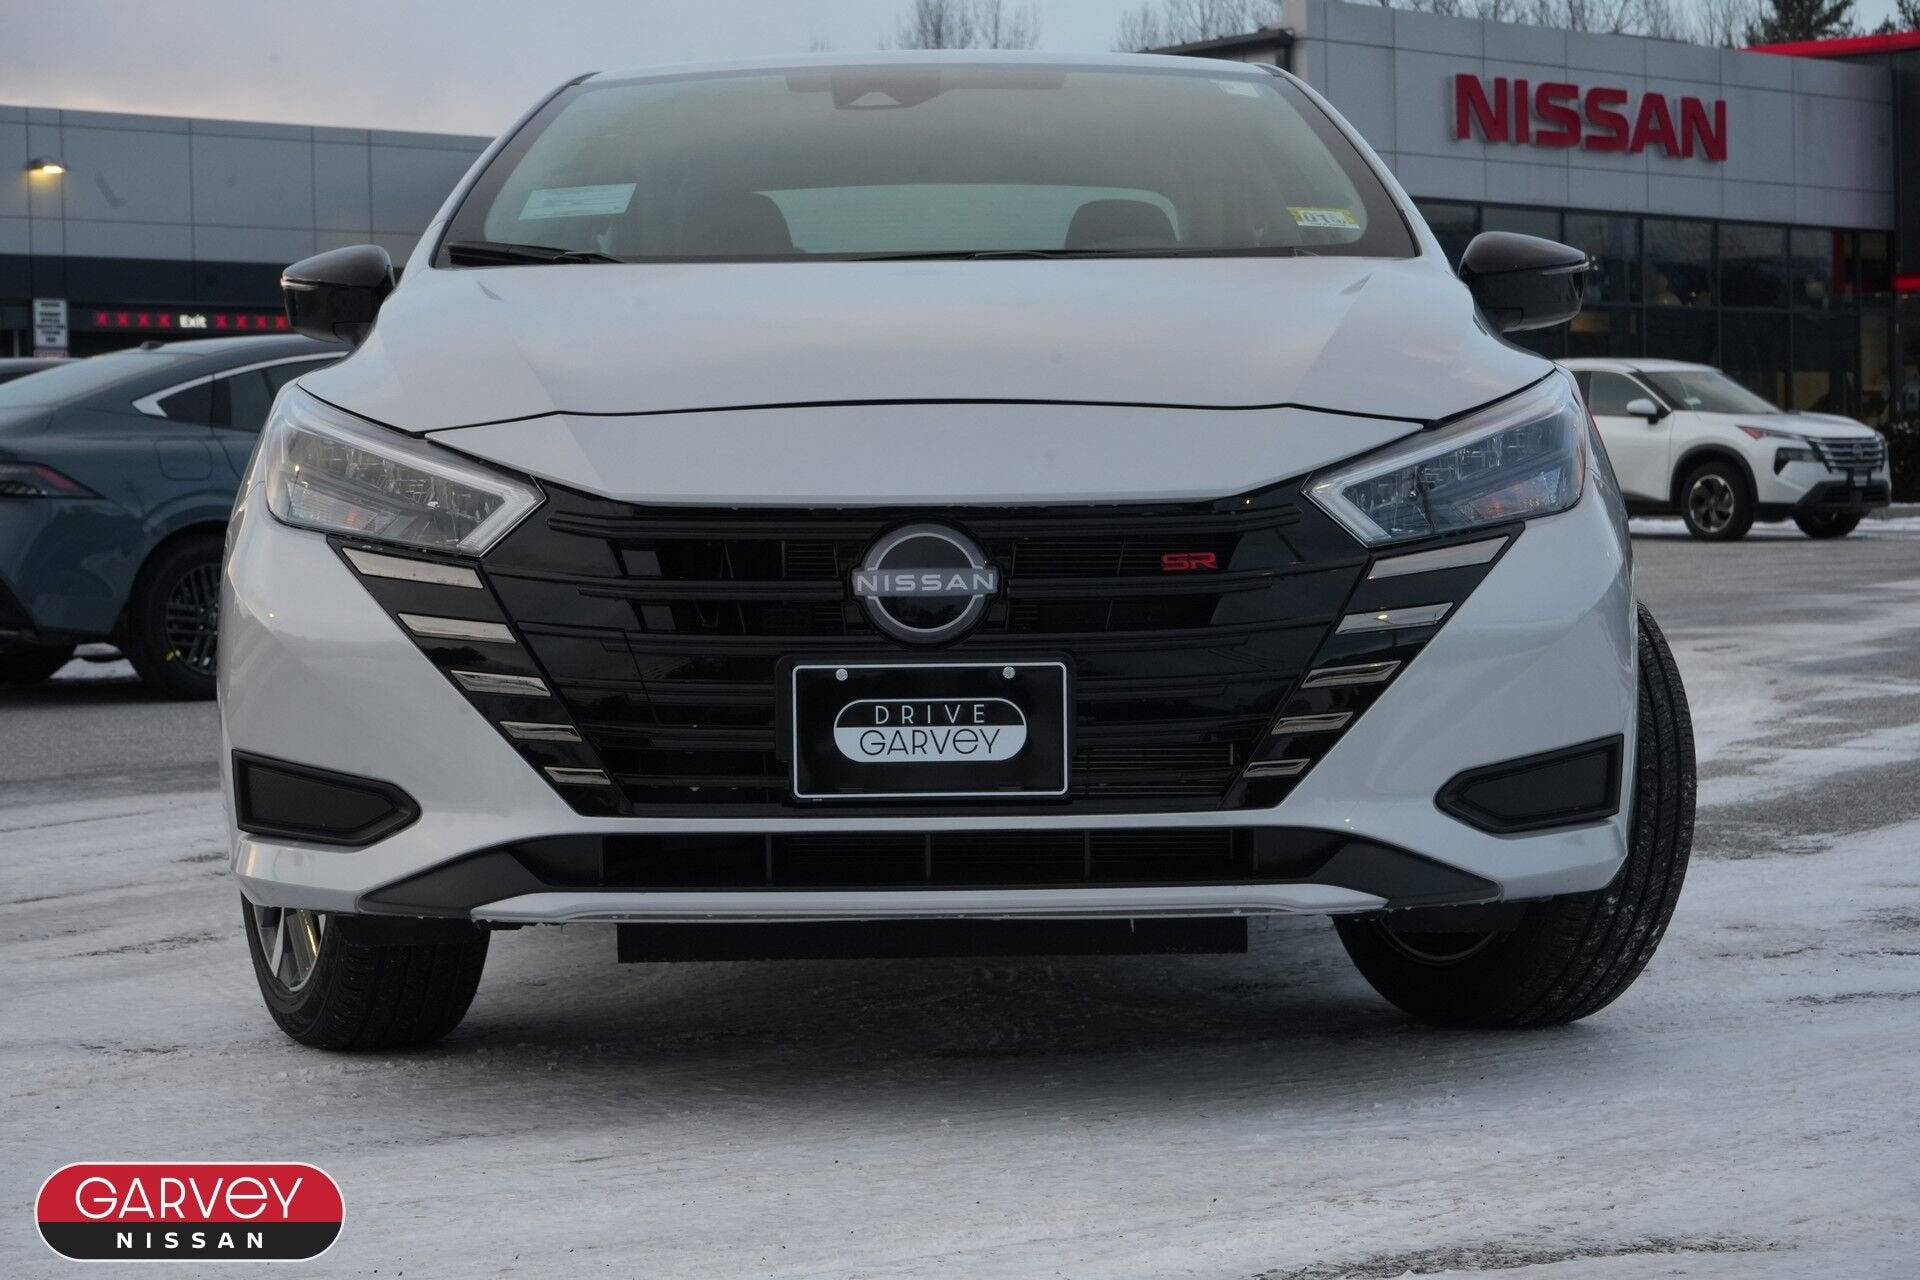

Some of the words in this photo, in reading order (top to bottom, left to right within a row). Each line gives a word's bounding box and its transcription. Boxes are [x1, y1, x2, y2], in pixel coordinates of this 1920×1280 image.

[1455, 73, 1727, 161] NISSAN
[178, 313, 208, 329] Exit
[1160, 552, 1218, 571] SR
[856, 573, 997, 592] NISSAN
[874, 703, 986, 725] DRIVE
